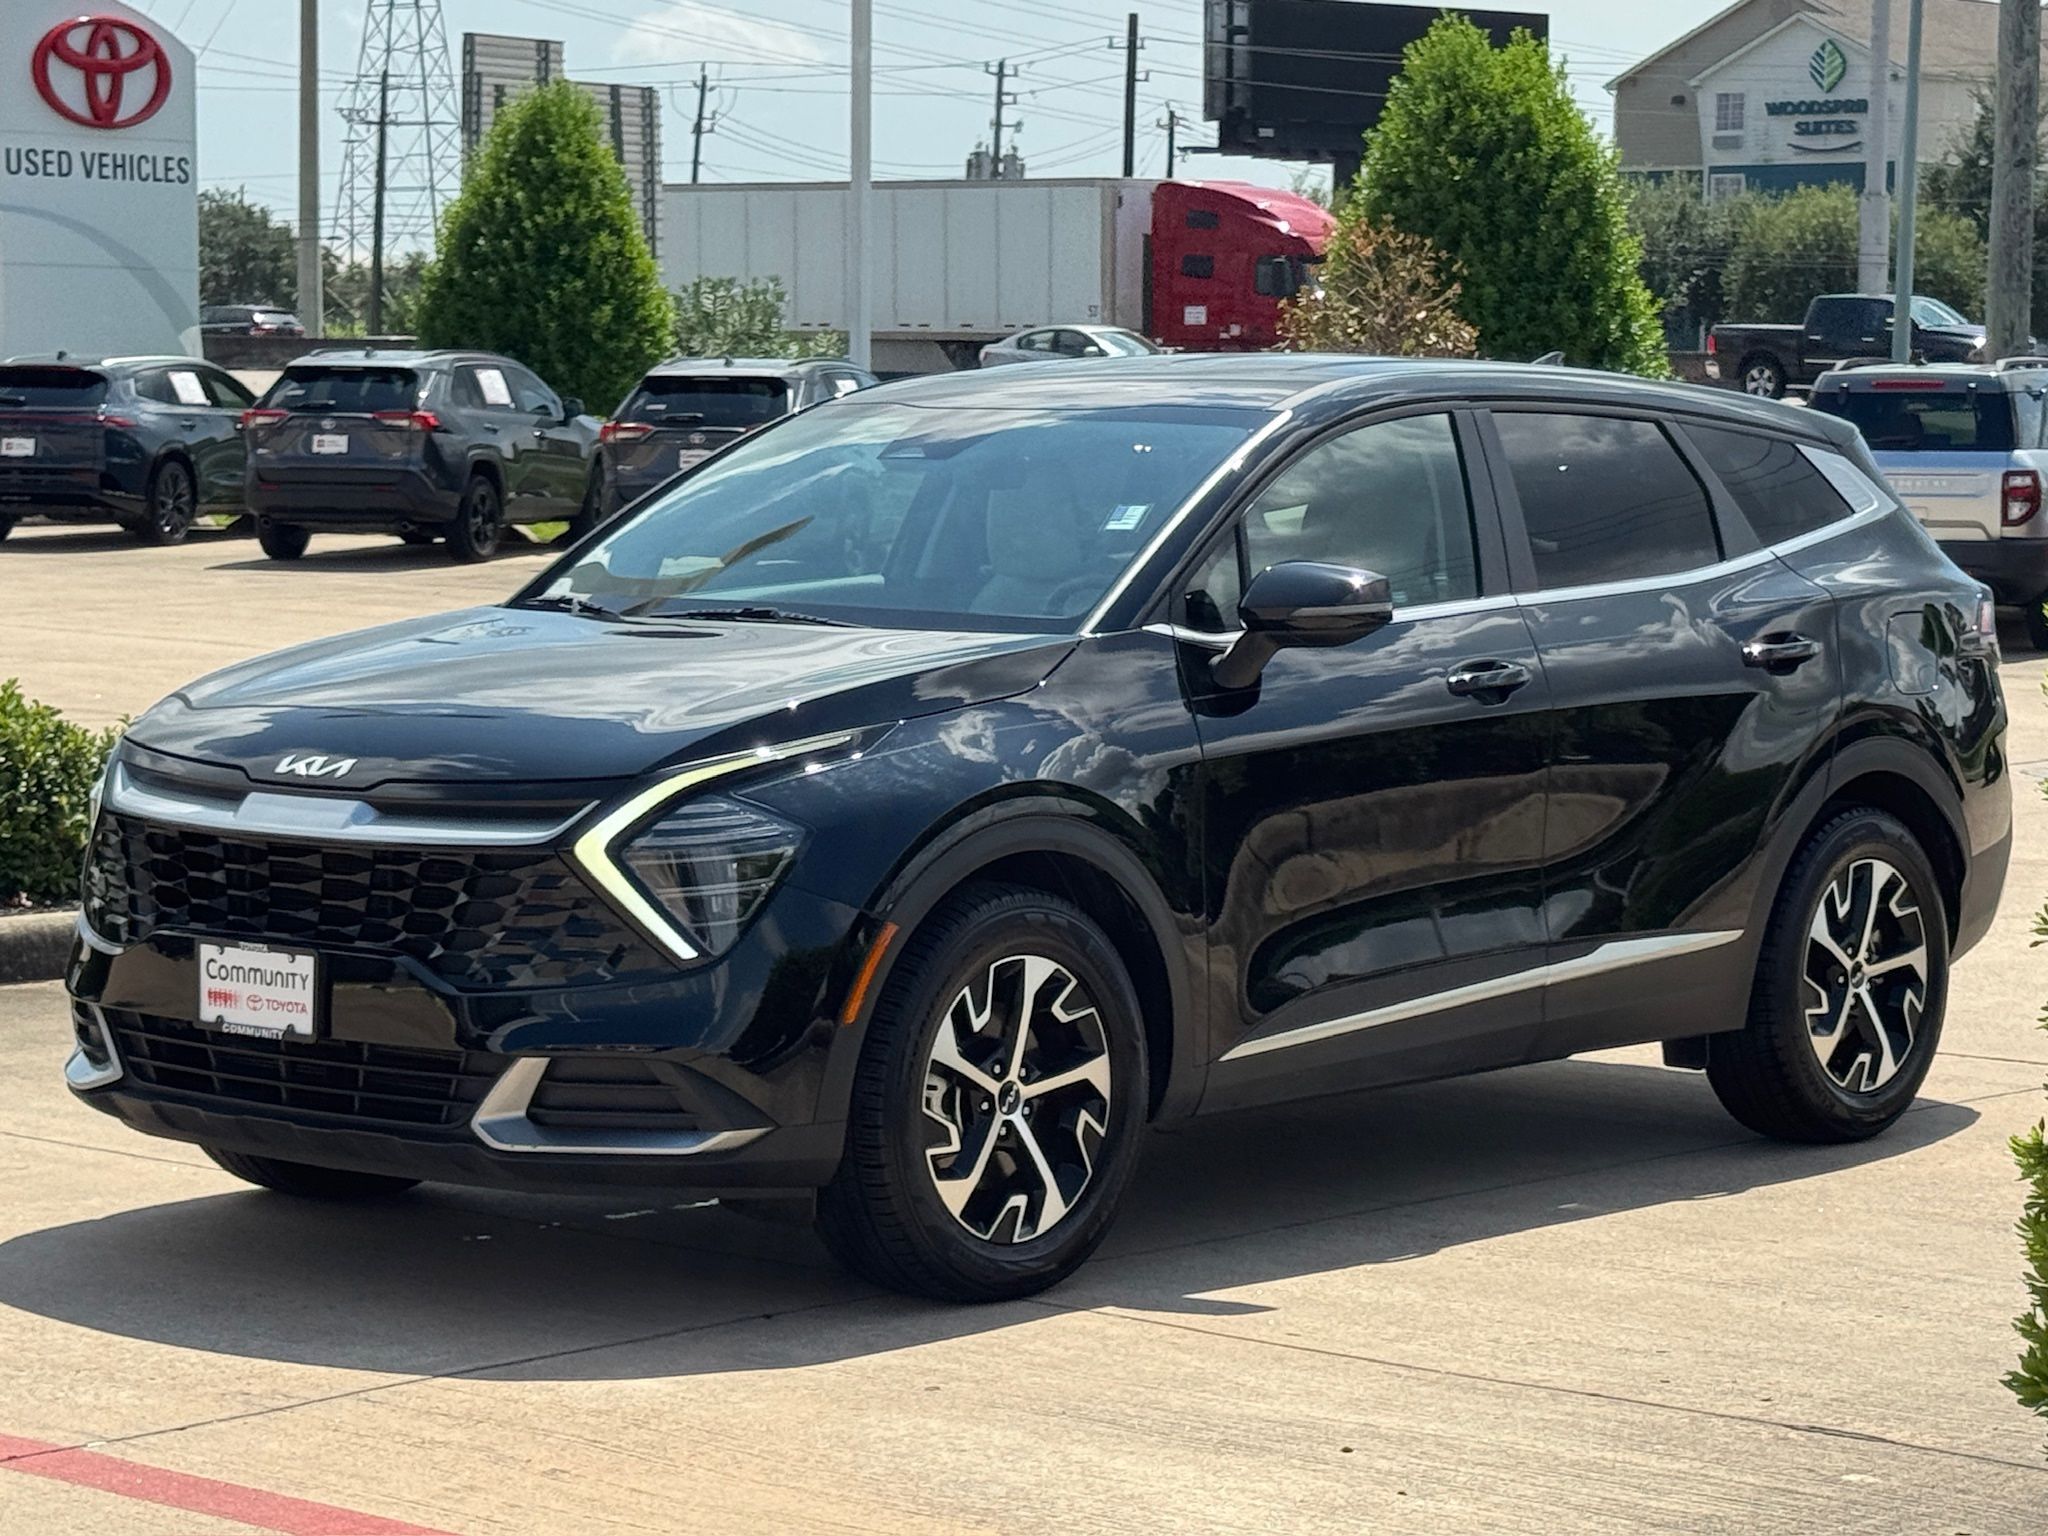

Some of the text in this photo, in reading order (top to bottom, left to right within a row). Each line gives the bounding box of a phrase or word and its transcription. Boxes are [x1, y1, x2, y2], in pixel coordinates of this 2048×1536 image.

[1793, 119, 1858, 135] SUITES
[5, 147, 190, 184] USED VEHICLES
[265, 998, 308, 1014] TOYOTA
[222, 1023, 285, 1040] COMMUNITY
